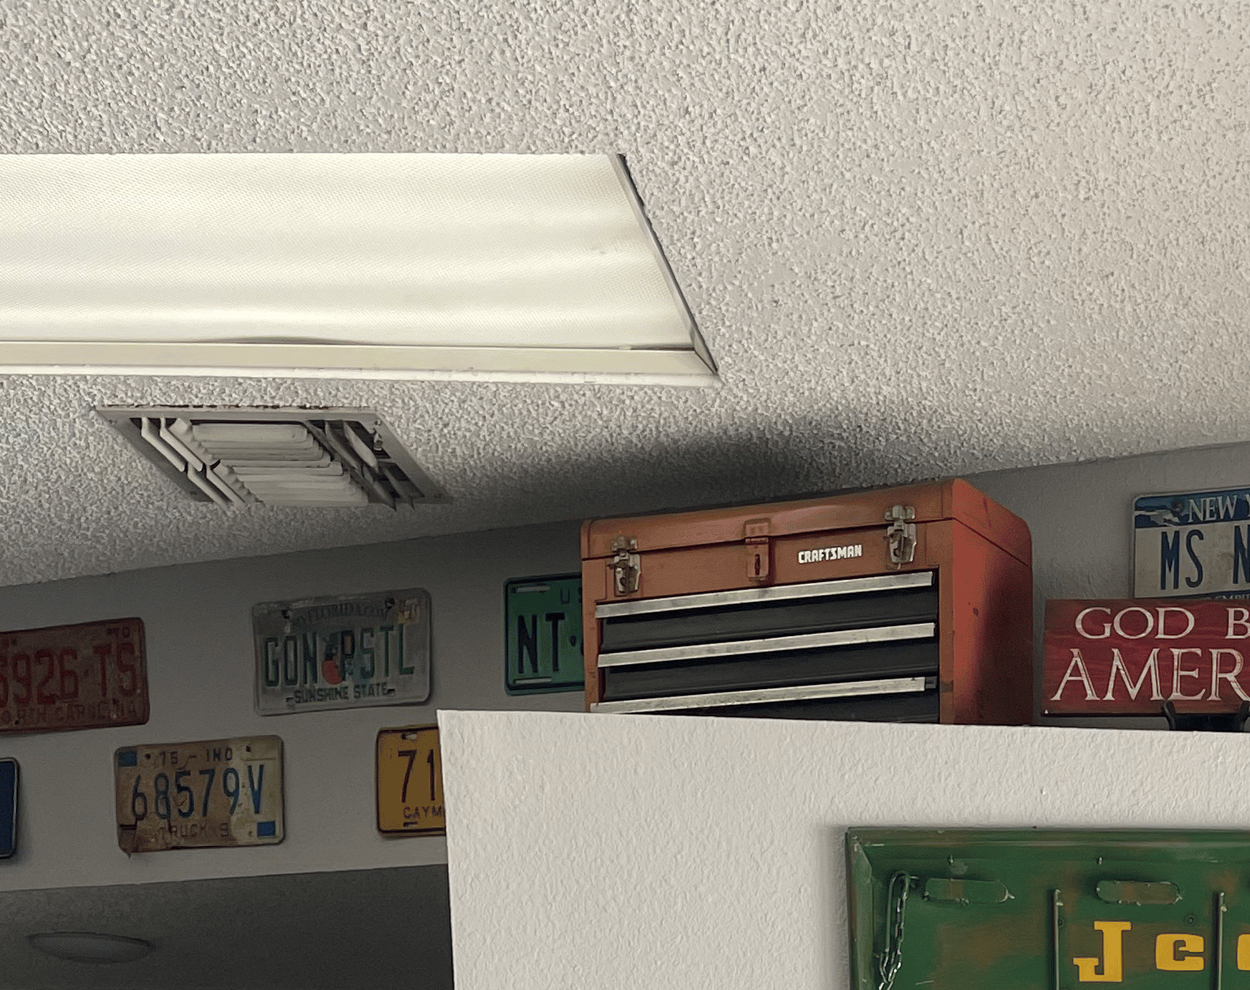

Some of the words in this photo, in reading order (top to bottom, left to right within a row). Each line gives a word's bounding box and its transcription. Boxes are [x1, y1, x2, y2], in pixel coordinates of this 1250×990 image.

[1188, 495, 1237, 523] NEW
[798, 544, 862, 564] CRAFTSMAN
[1160, 529, 1204, 590] MS
[1074, 606, 1195, 640] GOD
[264, 631, 318, 687] GON
[339, 623, 415, 682] PSTL
[294, 685, 349, 704] SUNSHINE
[354, 681, 389, 699] STATE
[132, 764, 264, 821] 68579V
[402, 805, 446, 819] CAYM
